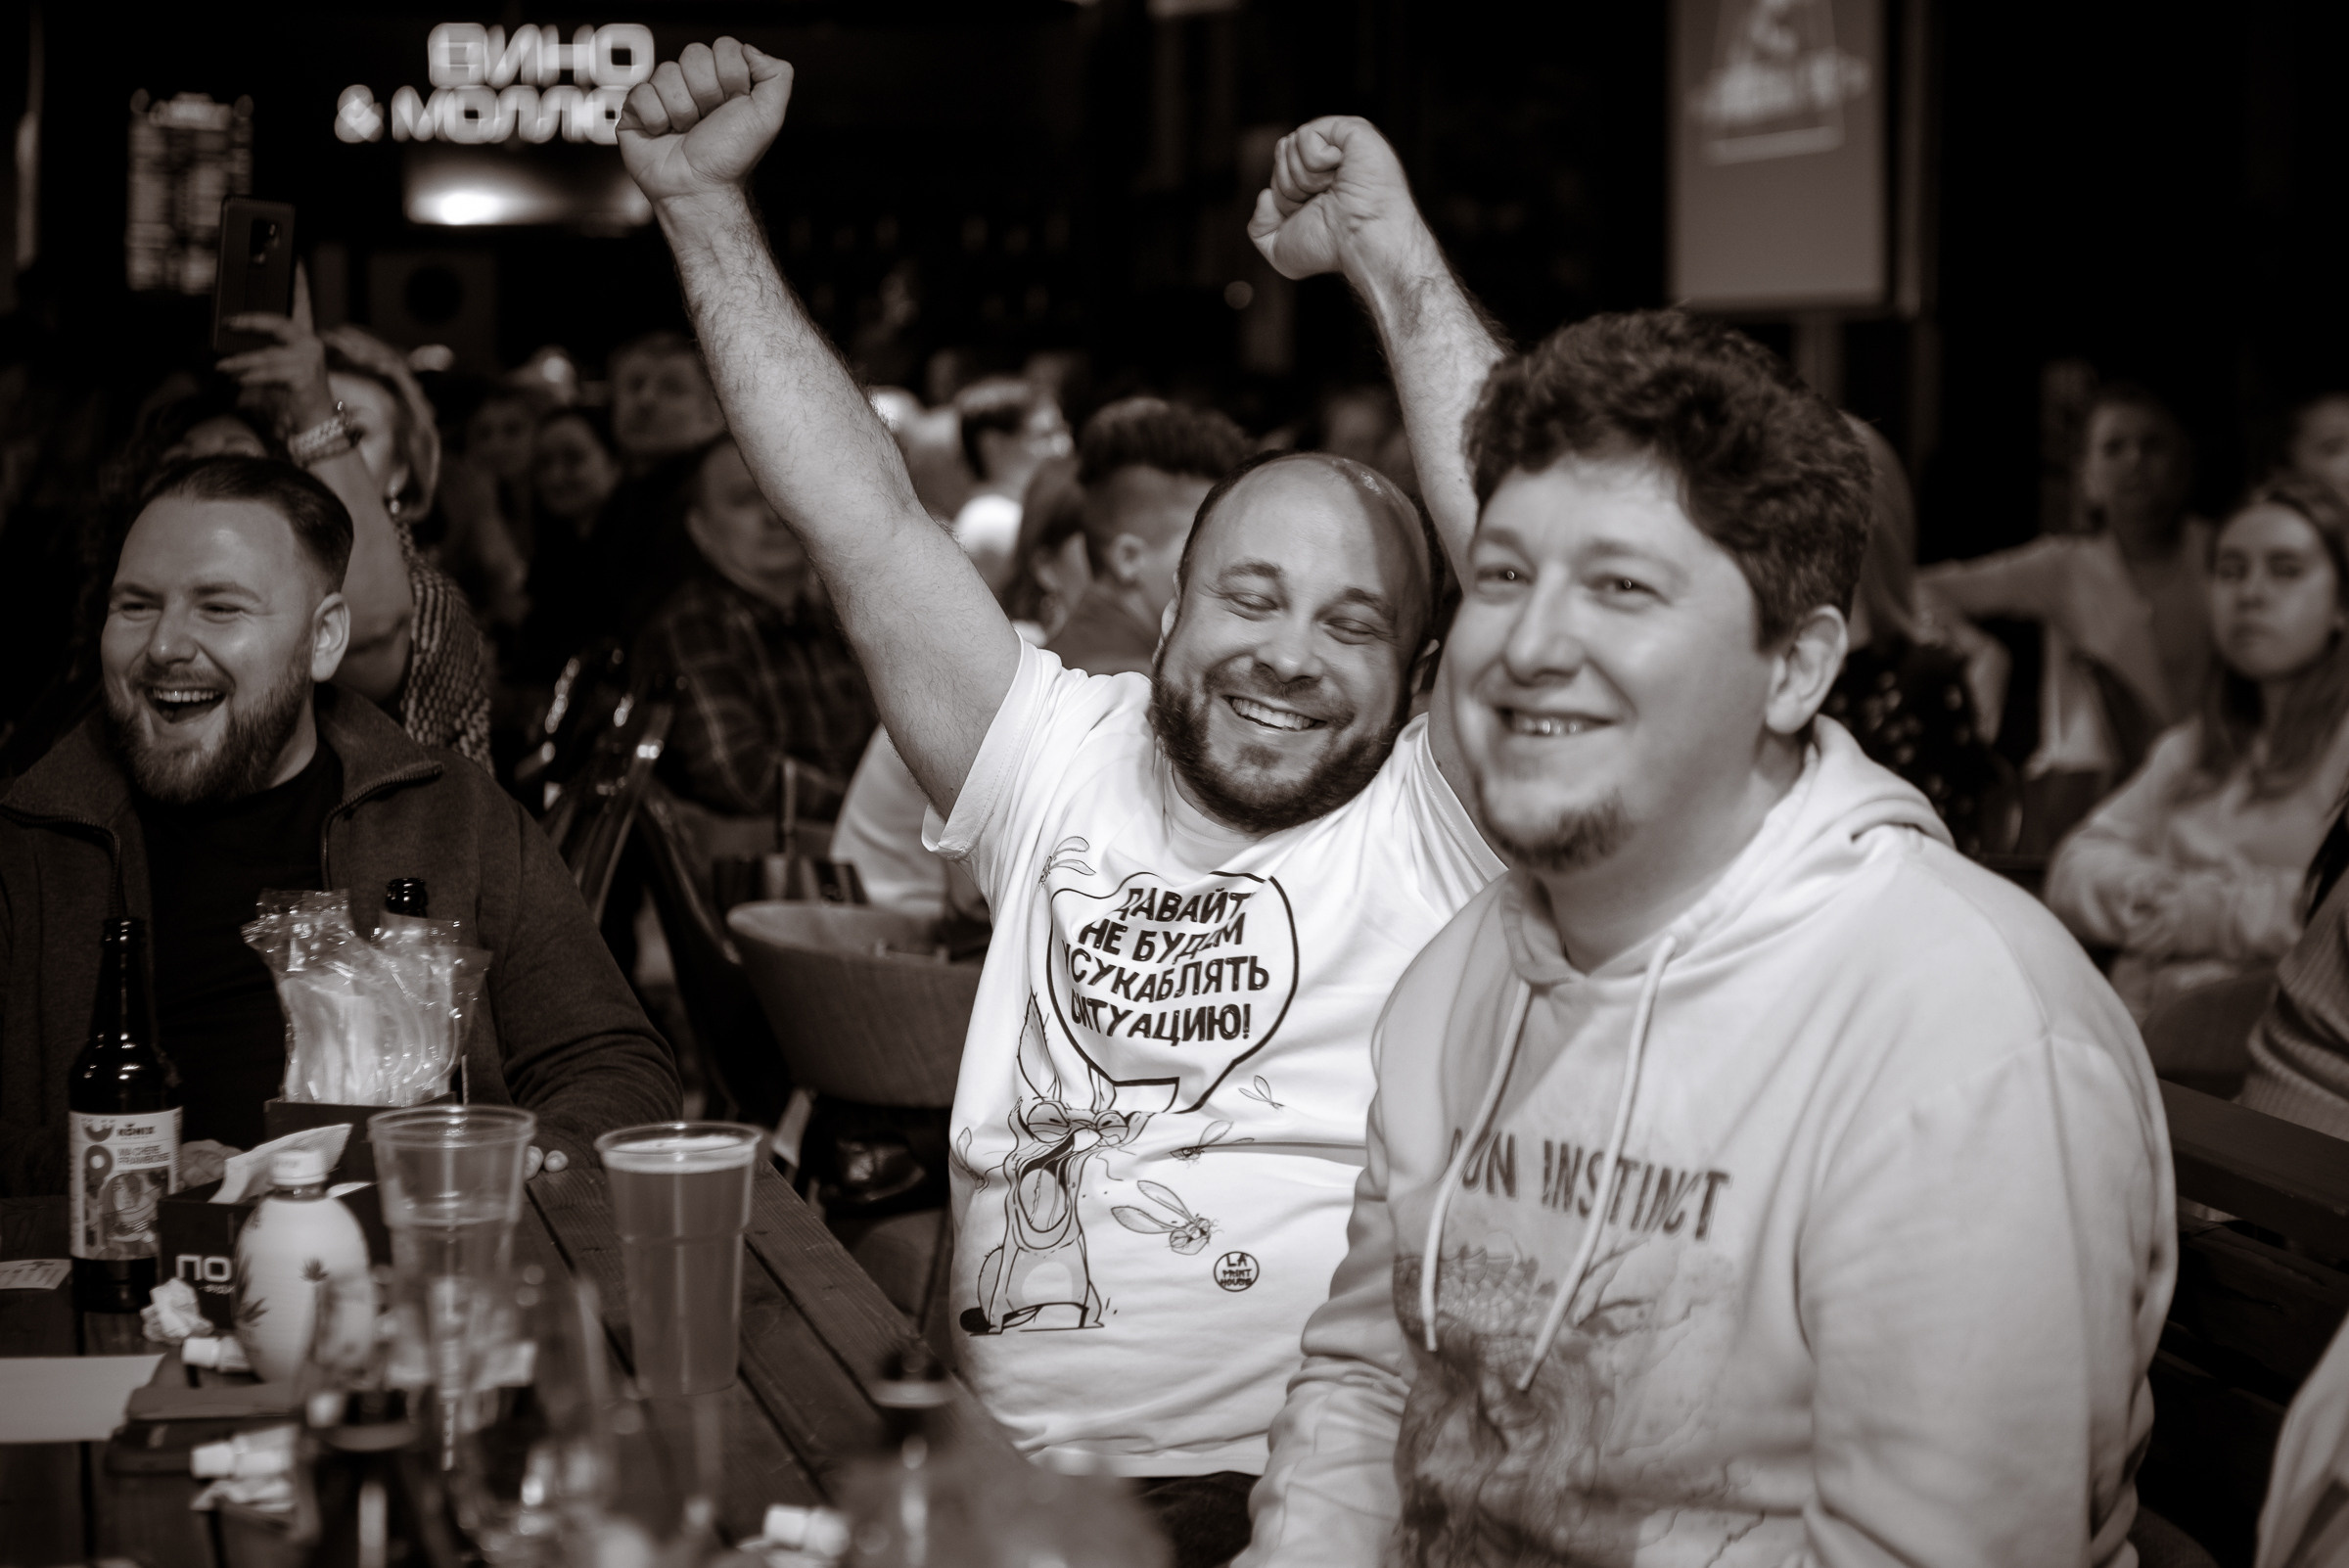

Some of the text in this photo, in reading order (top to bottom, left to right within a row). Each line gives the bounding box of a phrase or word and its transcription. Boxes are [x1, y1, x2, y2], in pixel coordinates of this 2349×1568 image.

[428, 23, 654, 88] ВИНО
[334, 84, 385, 144] &
[1078, 918, 1128, 956] НЕ
[1071, 989, 1252, 1046] СИТУАЦИЮ!
[1226, 1253, 1247, 1267] LA
